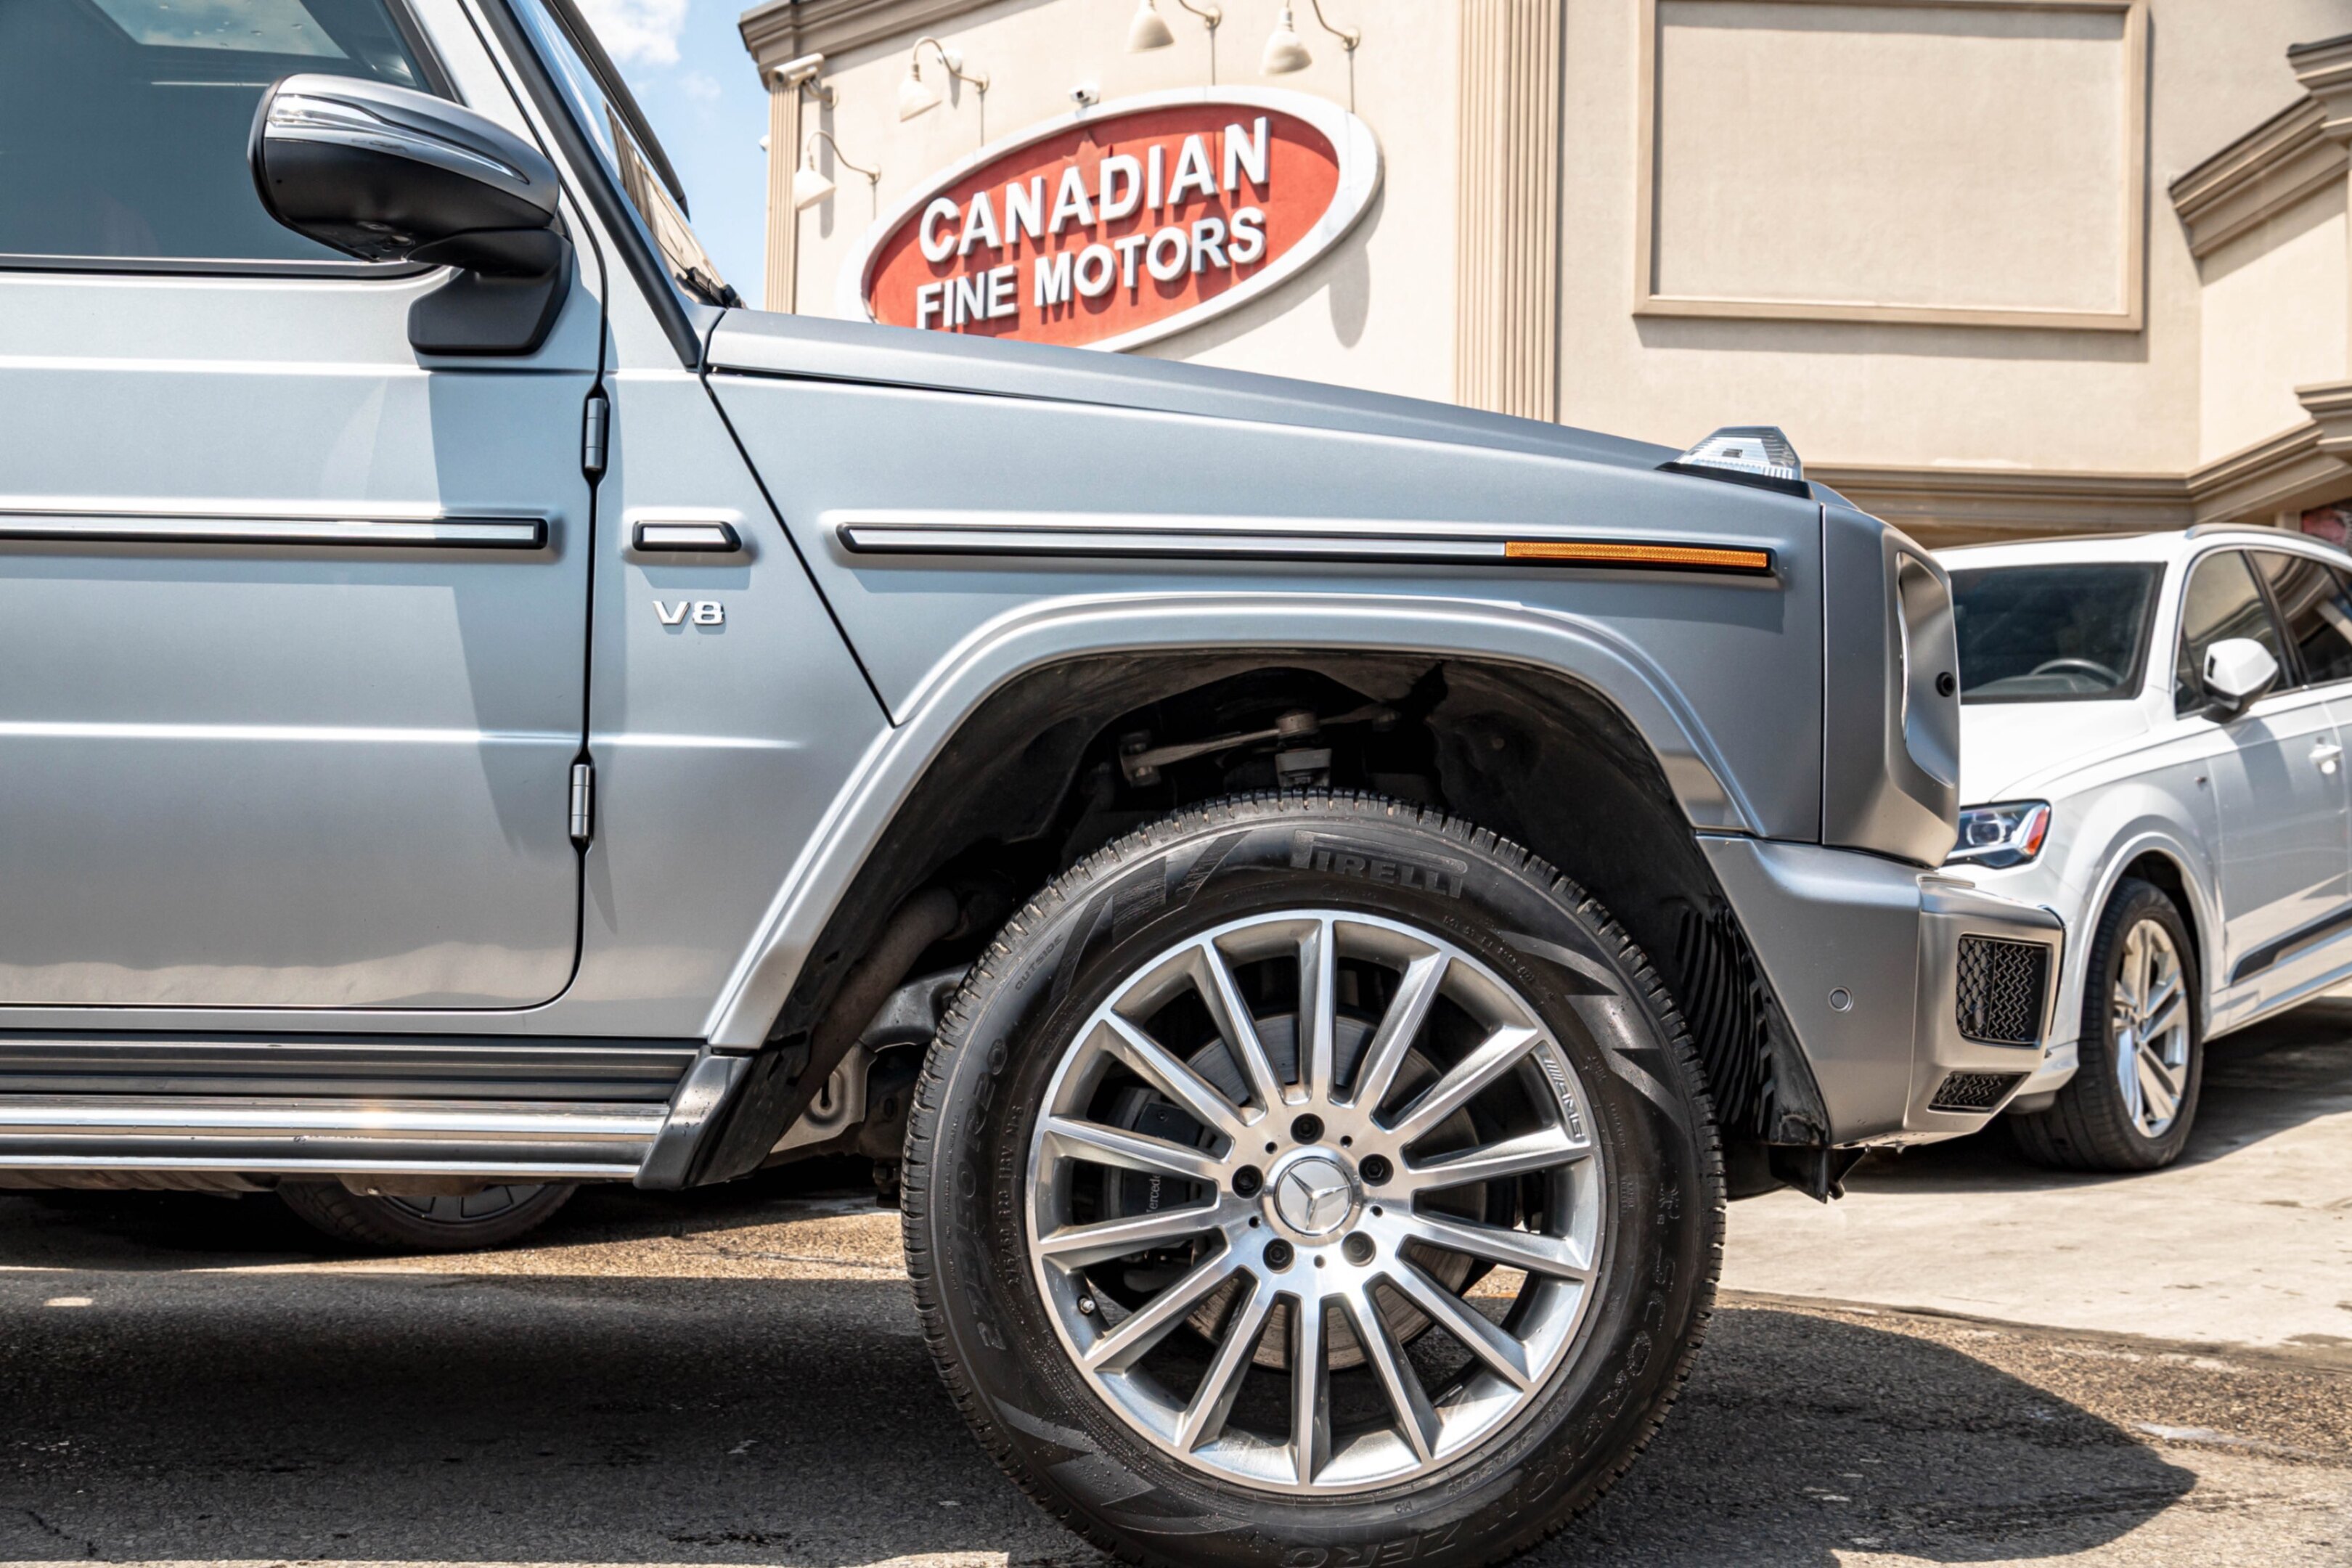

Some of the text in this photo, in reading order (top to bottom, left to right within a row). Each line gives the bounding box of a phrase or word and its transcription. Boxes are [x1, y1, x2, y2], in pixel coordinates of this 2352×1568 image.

[919, 116, 1271, 263] CANADIAN
[916, 207, 1266, 329] FINE MOTORS
[653, 600, 724, 625] V8
[1290, 830, 1468, 899] PIRELLI
[1015, 934, 1063, 990] OUTSIDE
